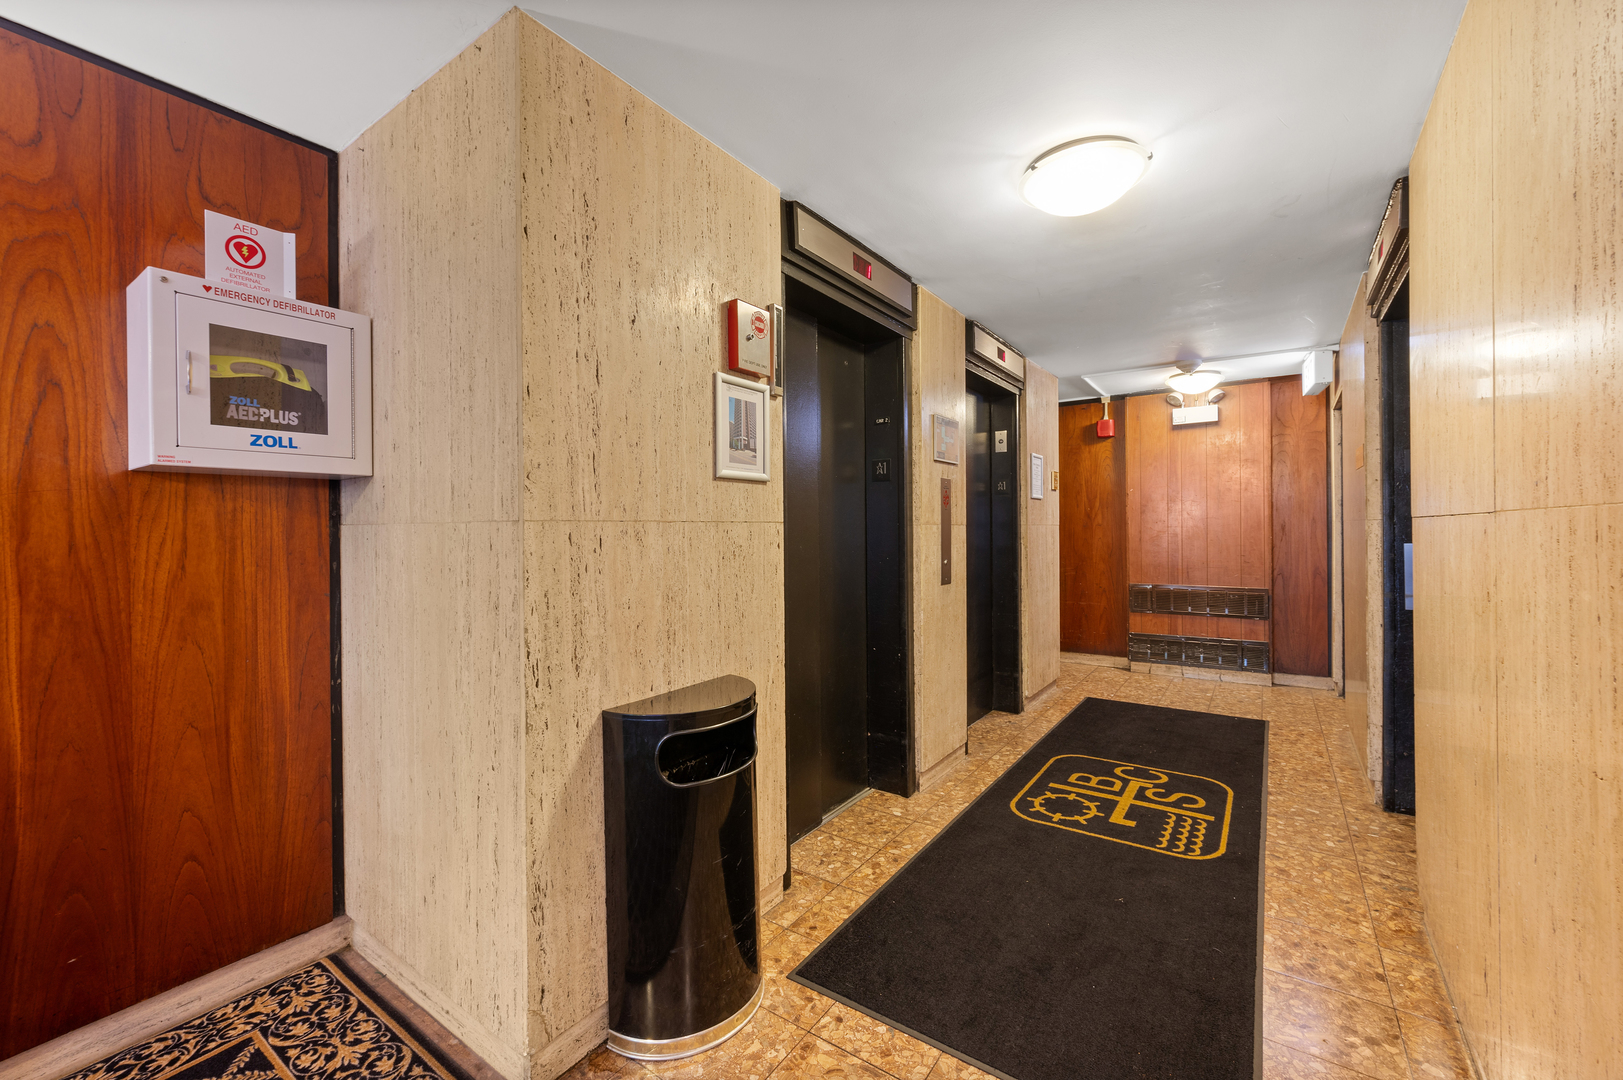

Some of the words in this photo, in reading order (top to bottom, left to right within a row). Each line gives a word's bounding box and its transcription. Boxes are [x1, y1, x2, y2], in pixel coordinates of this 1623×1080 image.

[233, 222, 259, 237] AED
[225, 266, 266, 280] AUTOMATED
[229, 273, 263, 285] EXTERNAL
[220, 277, 271, 293] DEFIBRILLATOR
[214, 286, 271, 306] EMERGENCY
[273, 299, 336, 320] DEFIBRILLATOR
[229, 395, 261, 408] ZOLL
[249, 434, 298, 449] ZOLL
